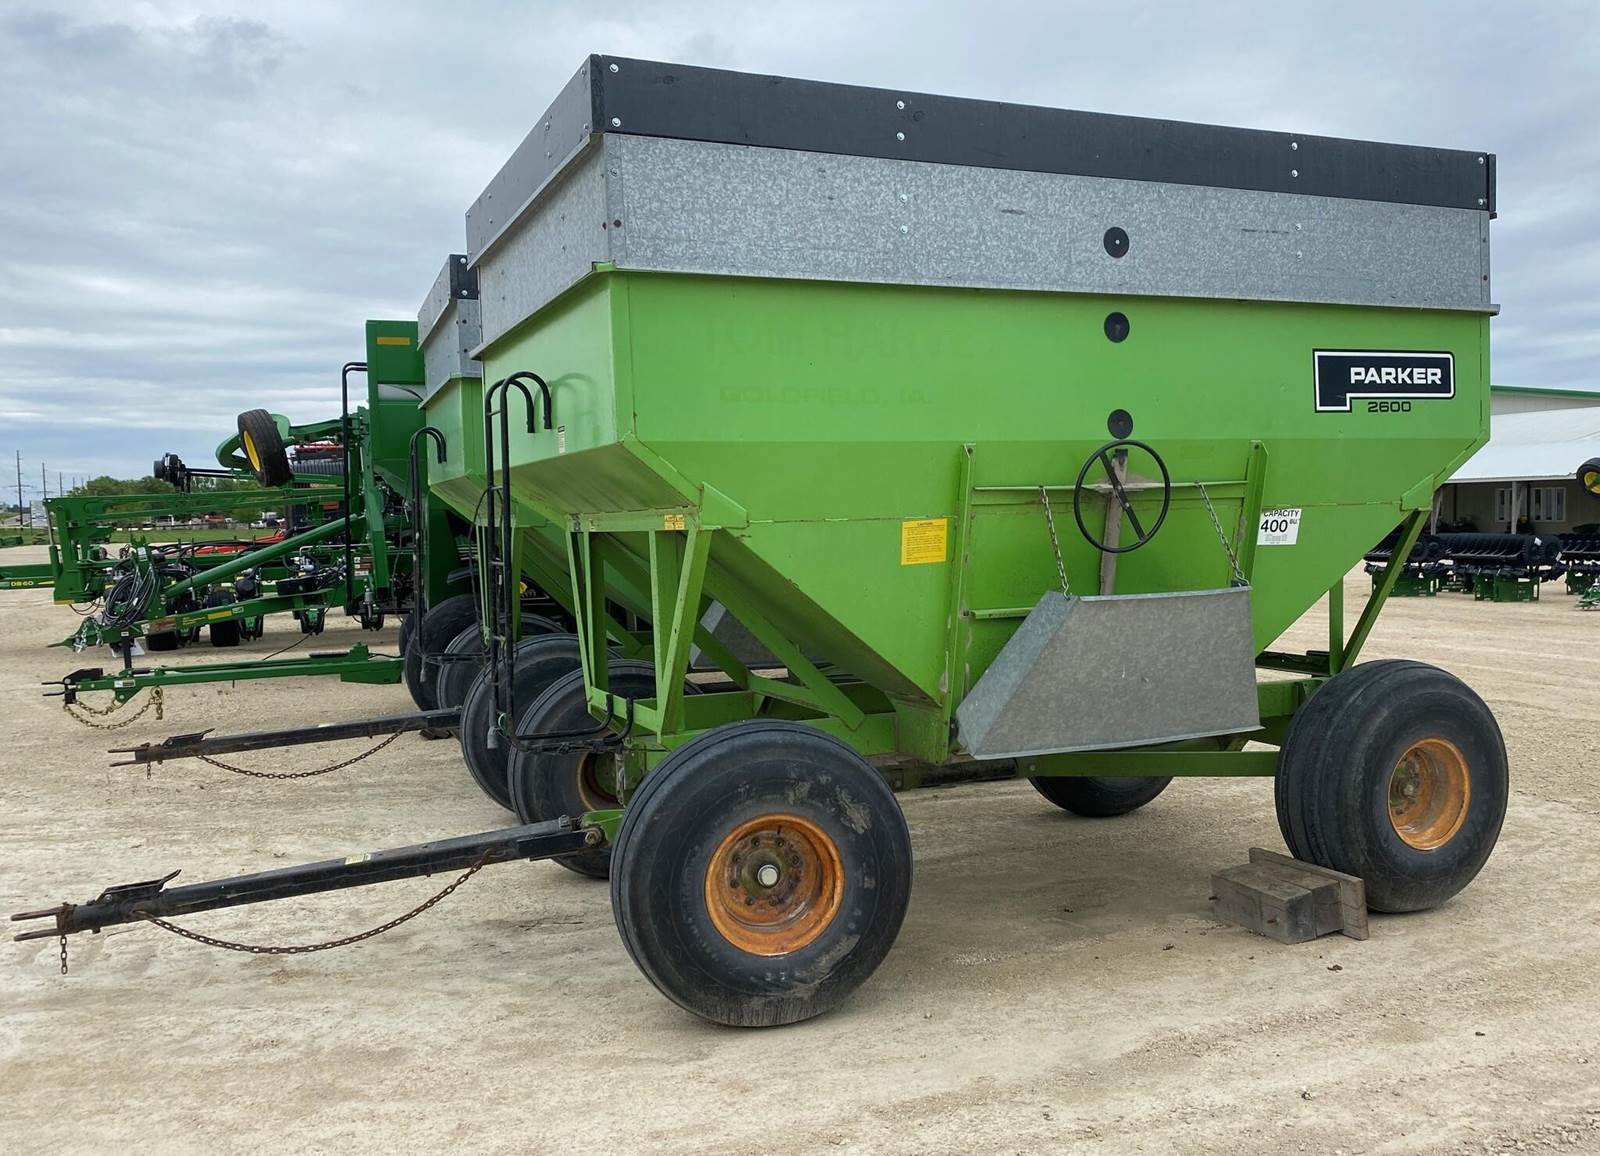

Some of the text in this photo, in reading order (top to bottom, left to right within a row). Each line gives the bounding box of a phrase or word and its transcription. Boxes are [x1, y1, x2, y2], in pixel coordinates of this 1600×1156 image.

[1350, 367, 1441, 384] PARKER
[1368, 401, 1411, 412] 2600
[1263, 509, 1299, 517] CAPACITY
[1260, 519, 1288, 533] 400
